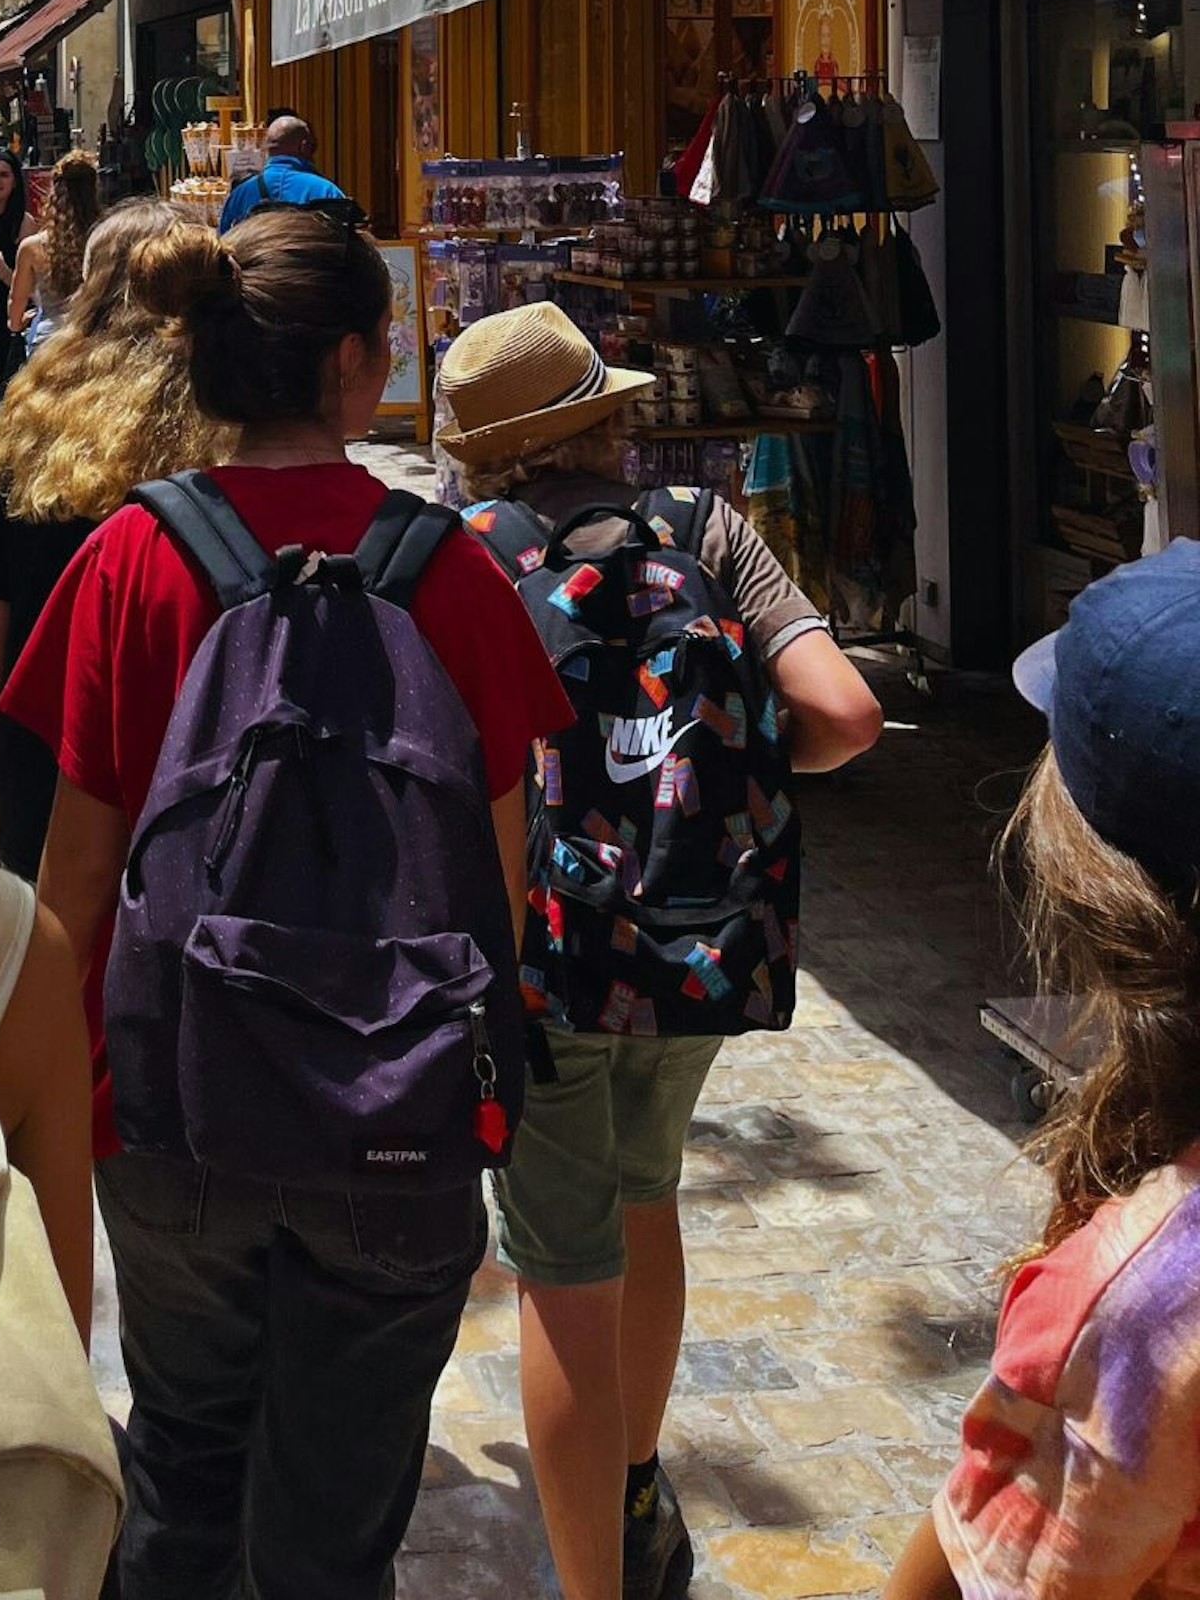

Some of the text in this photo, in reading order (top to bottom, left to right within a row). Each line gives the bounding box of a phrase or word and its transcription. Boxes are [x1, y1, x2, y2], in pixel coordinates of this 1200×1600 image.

[611, 706, 673, 756] NIKE
[657, 757, 676, 803] NIKE
[366, 1150, 427, 1162] EASTPAK
